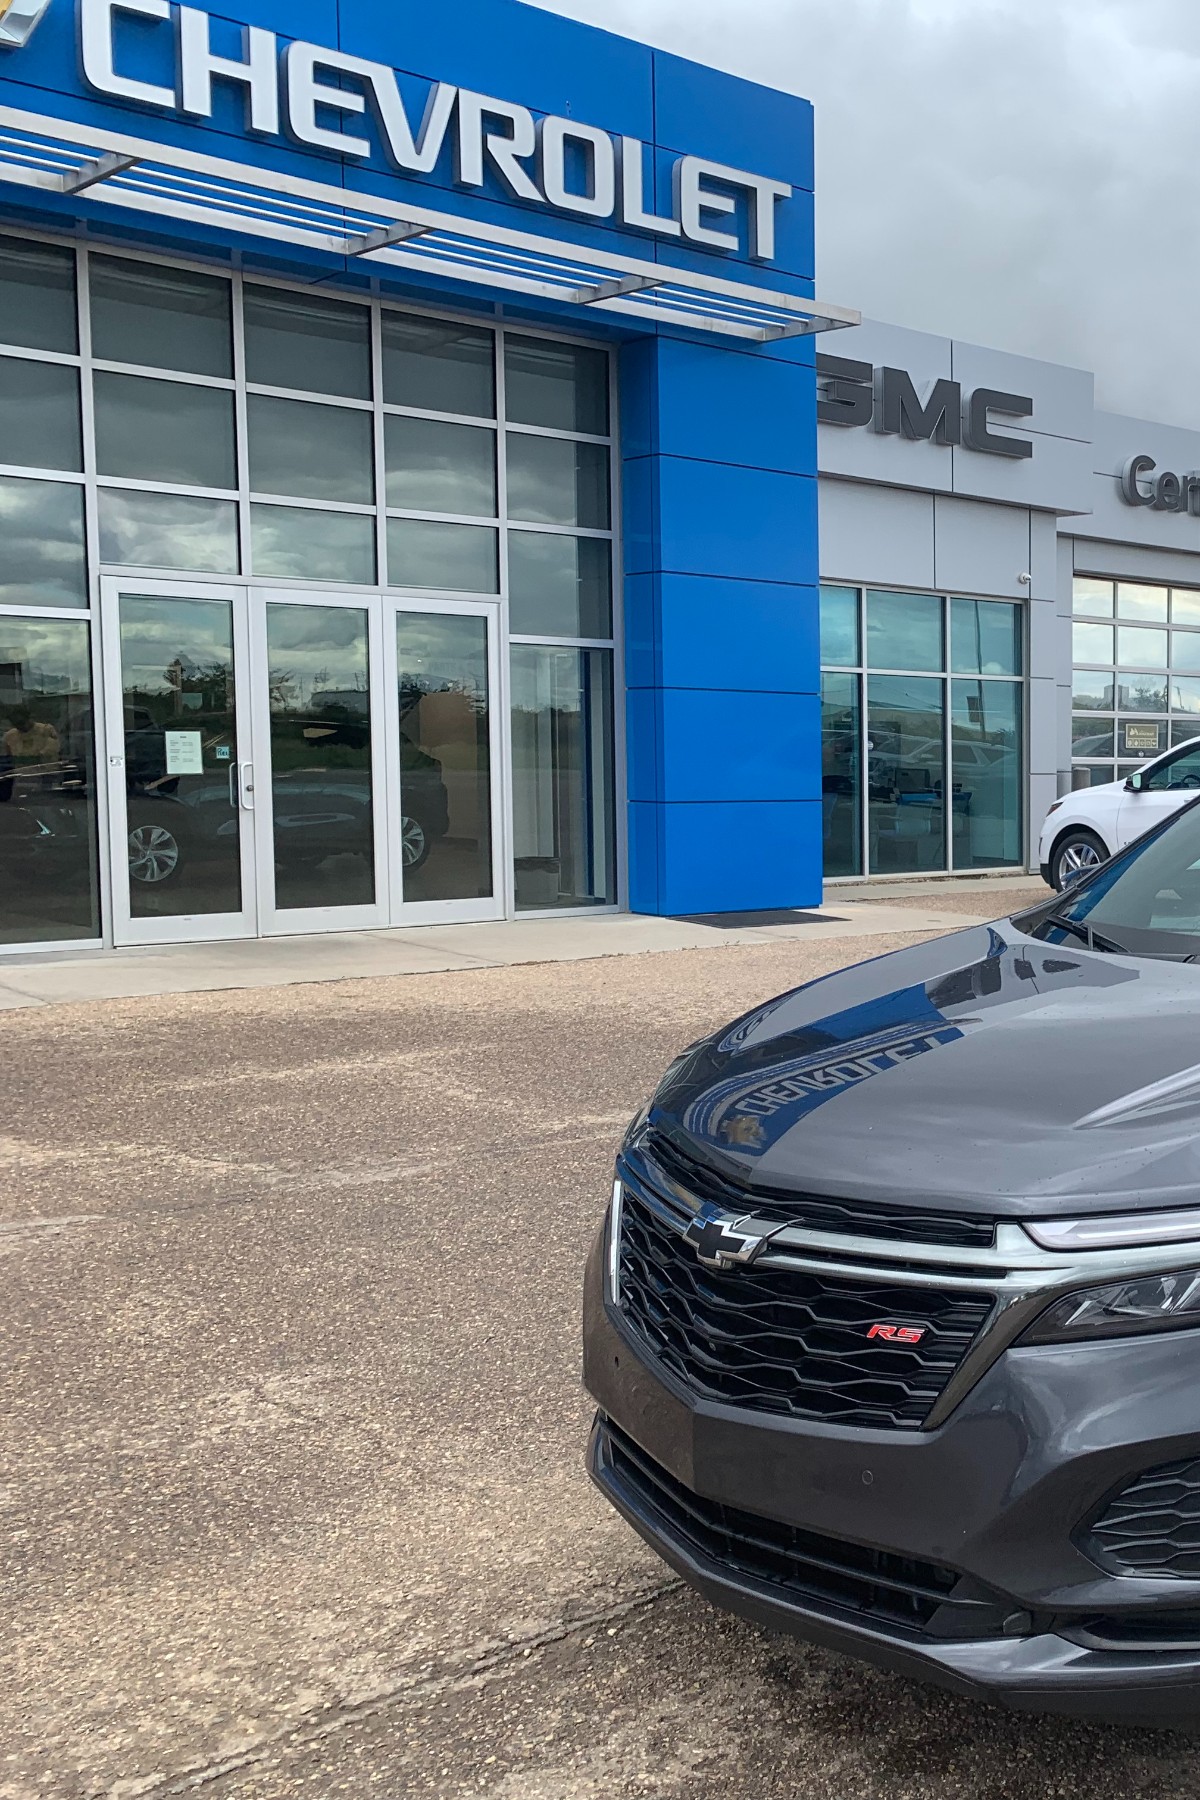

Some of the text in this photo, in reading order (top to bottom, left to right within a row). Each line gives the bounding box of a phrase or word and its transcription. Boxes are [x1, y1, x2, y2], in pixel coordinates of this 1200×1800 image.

[78, 0, 793, 262] CHEVROLET
[816, 352, 1033, 460] GMC
[866, 1324, 926, 1344] RS
